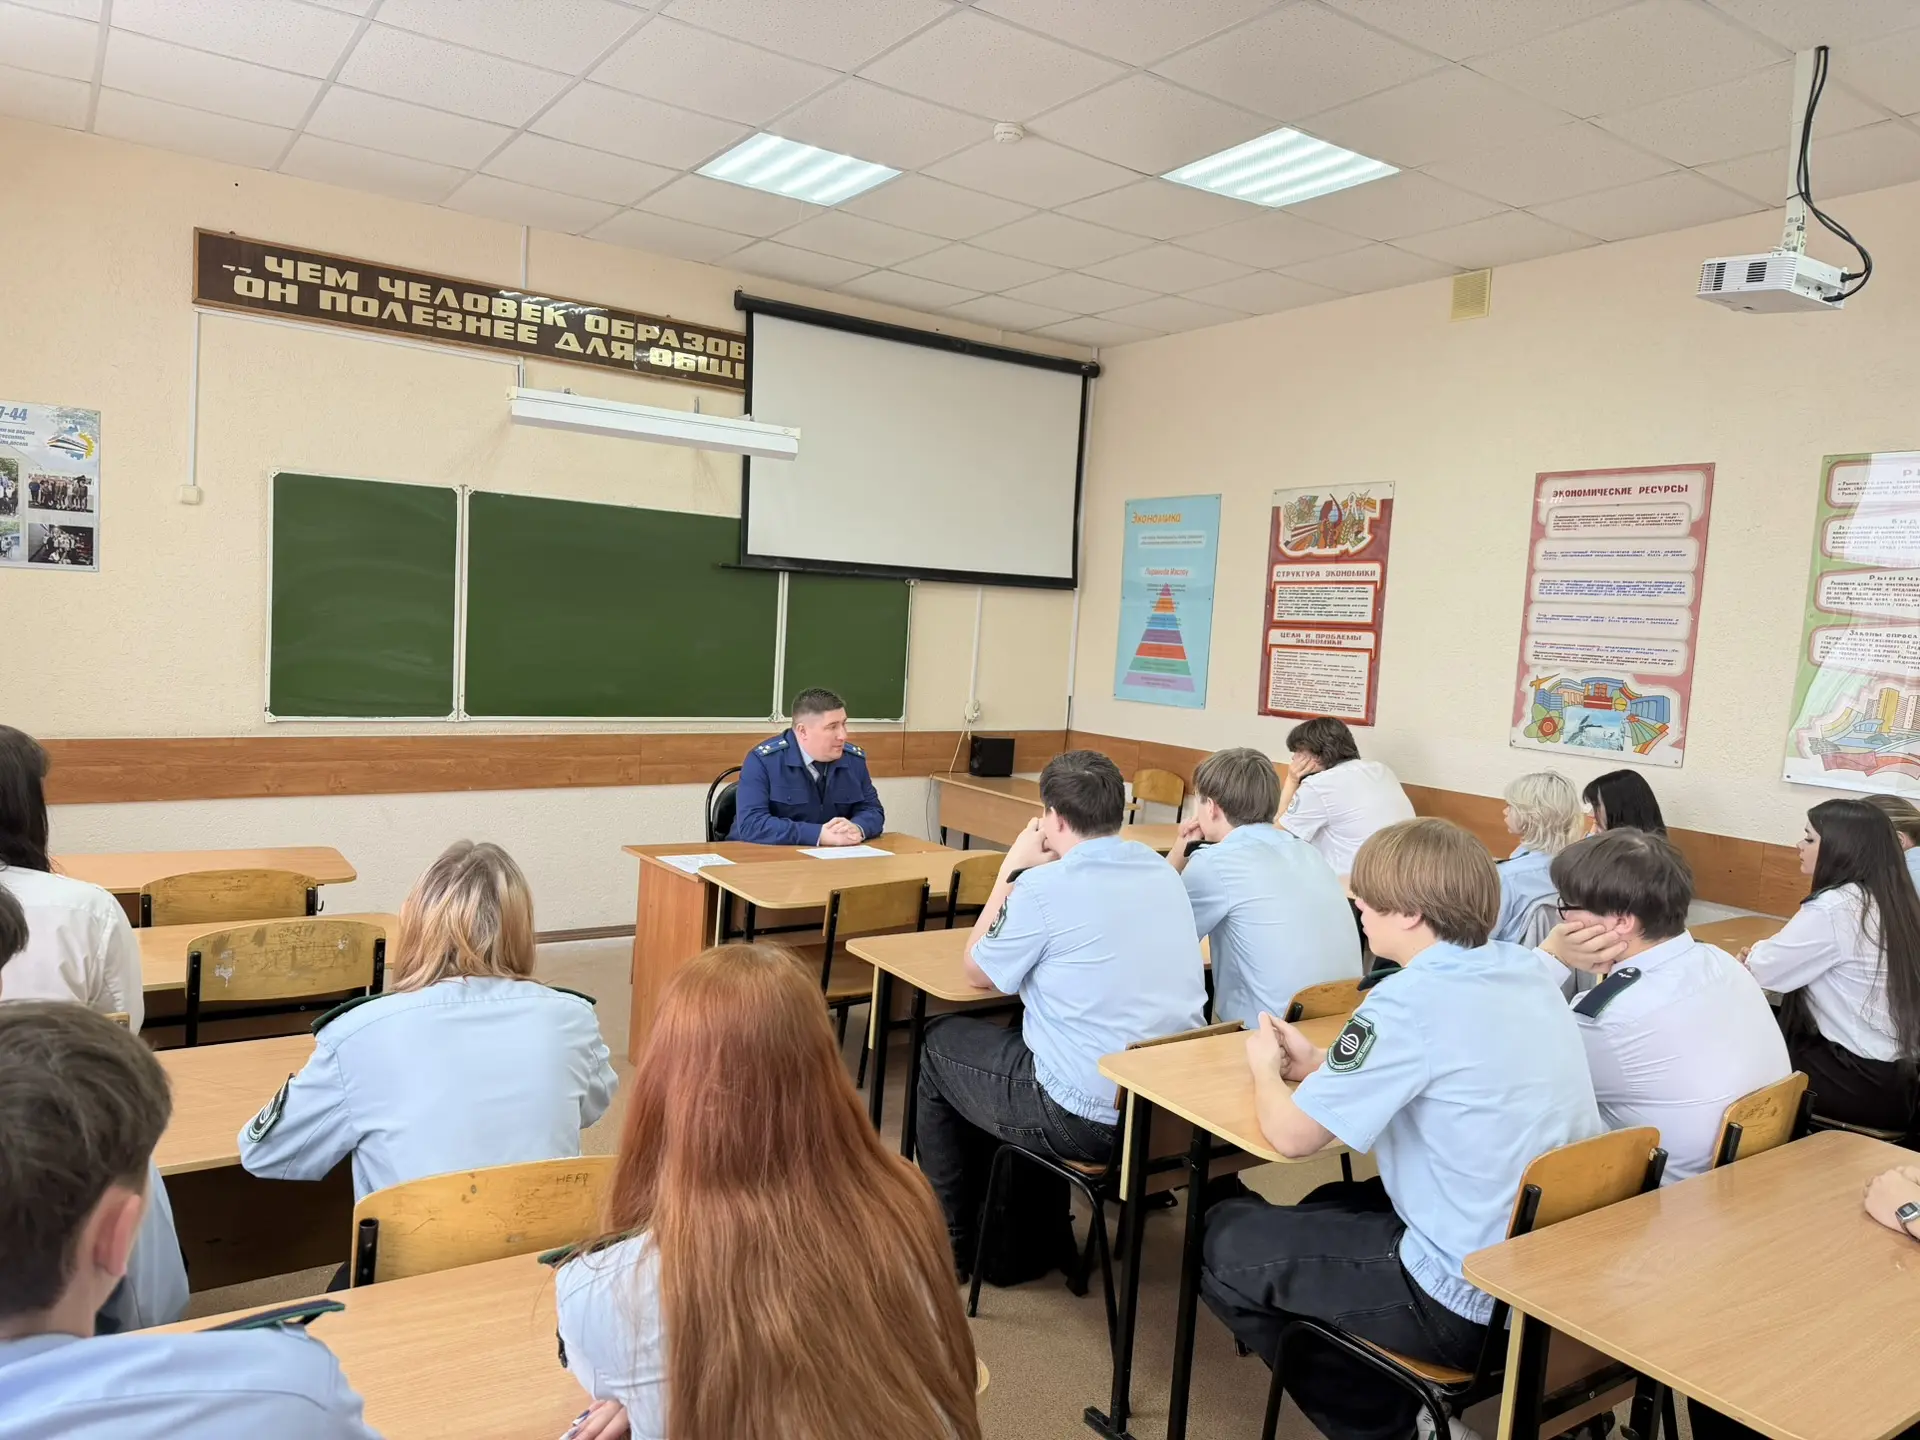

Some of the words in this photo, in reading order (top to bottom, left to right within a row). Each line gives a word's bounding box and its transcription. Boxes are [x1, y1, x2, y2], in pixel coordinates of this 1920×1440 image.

[233, 274, 299, 305] ОН
[319, 289, 538, 345] ПОЛЕЗНЕЕ
[555, 331, 635, 362] ДЛЯ
[378, 276, 568, 328] ЧЕЛОВЕК
[585, 313, 746, 361] ОБРАЗОВ
[1552, 486, 1633, 498] ЭКОНОМИЧЕСКИЕ
[1638, 484, 1689, 495] РЕСУРСЫ
[1276, 570, 1320, 578] СТРУКТУРА
[1296, 638, 1342, 646] ЭКОНОМИКИ
[1315, 633, 1362, 641] ПРОБЛЕМЫ
